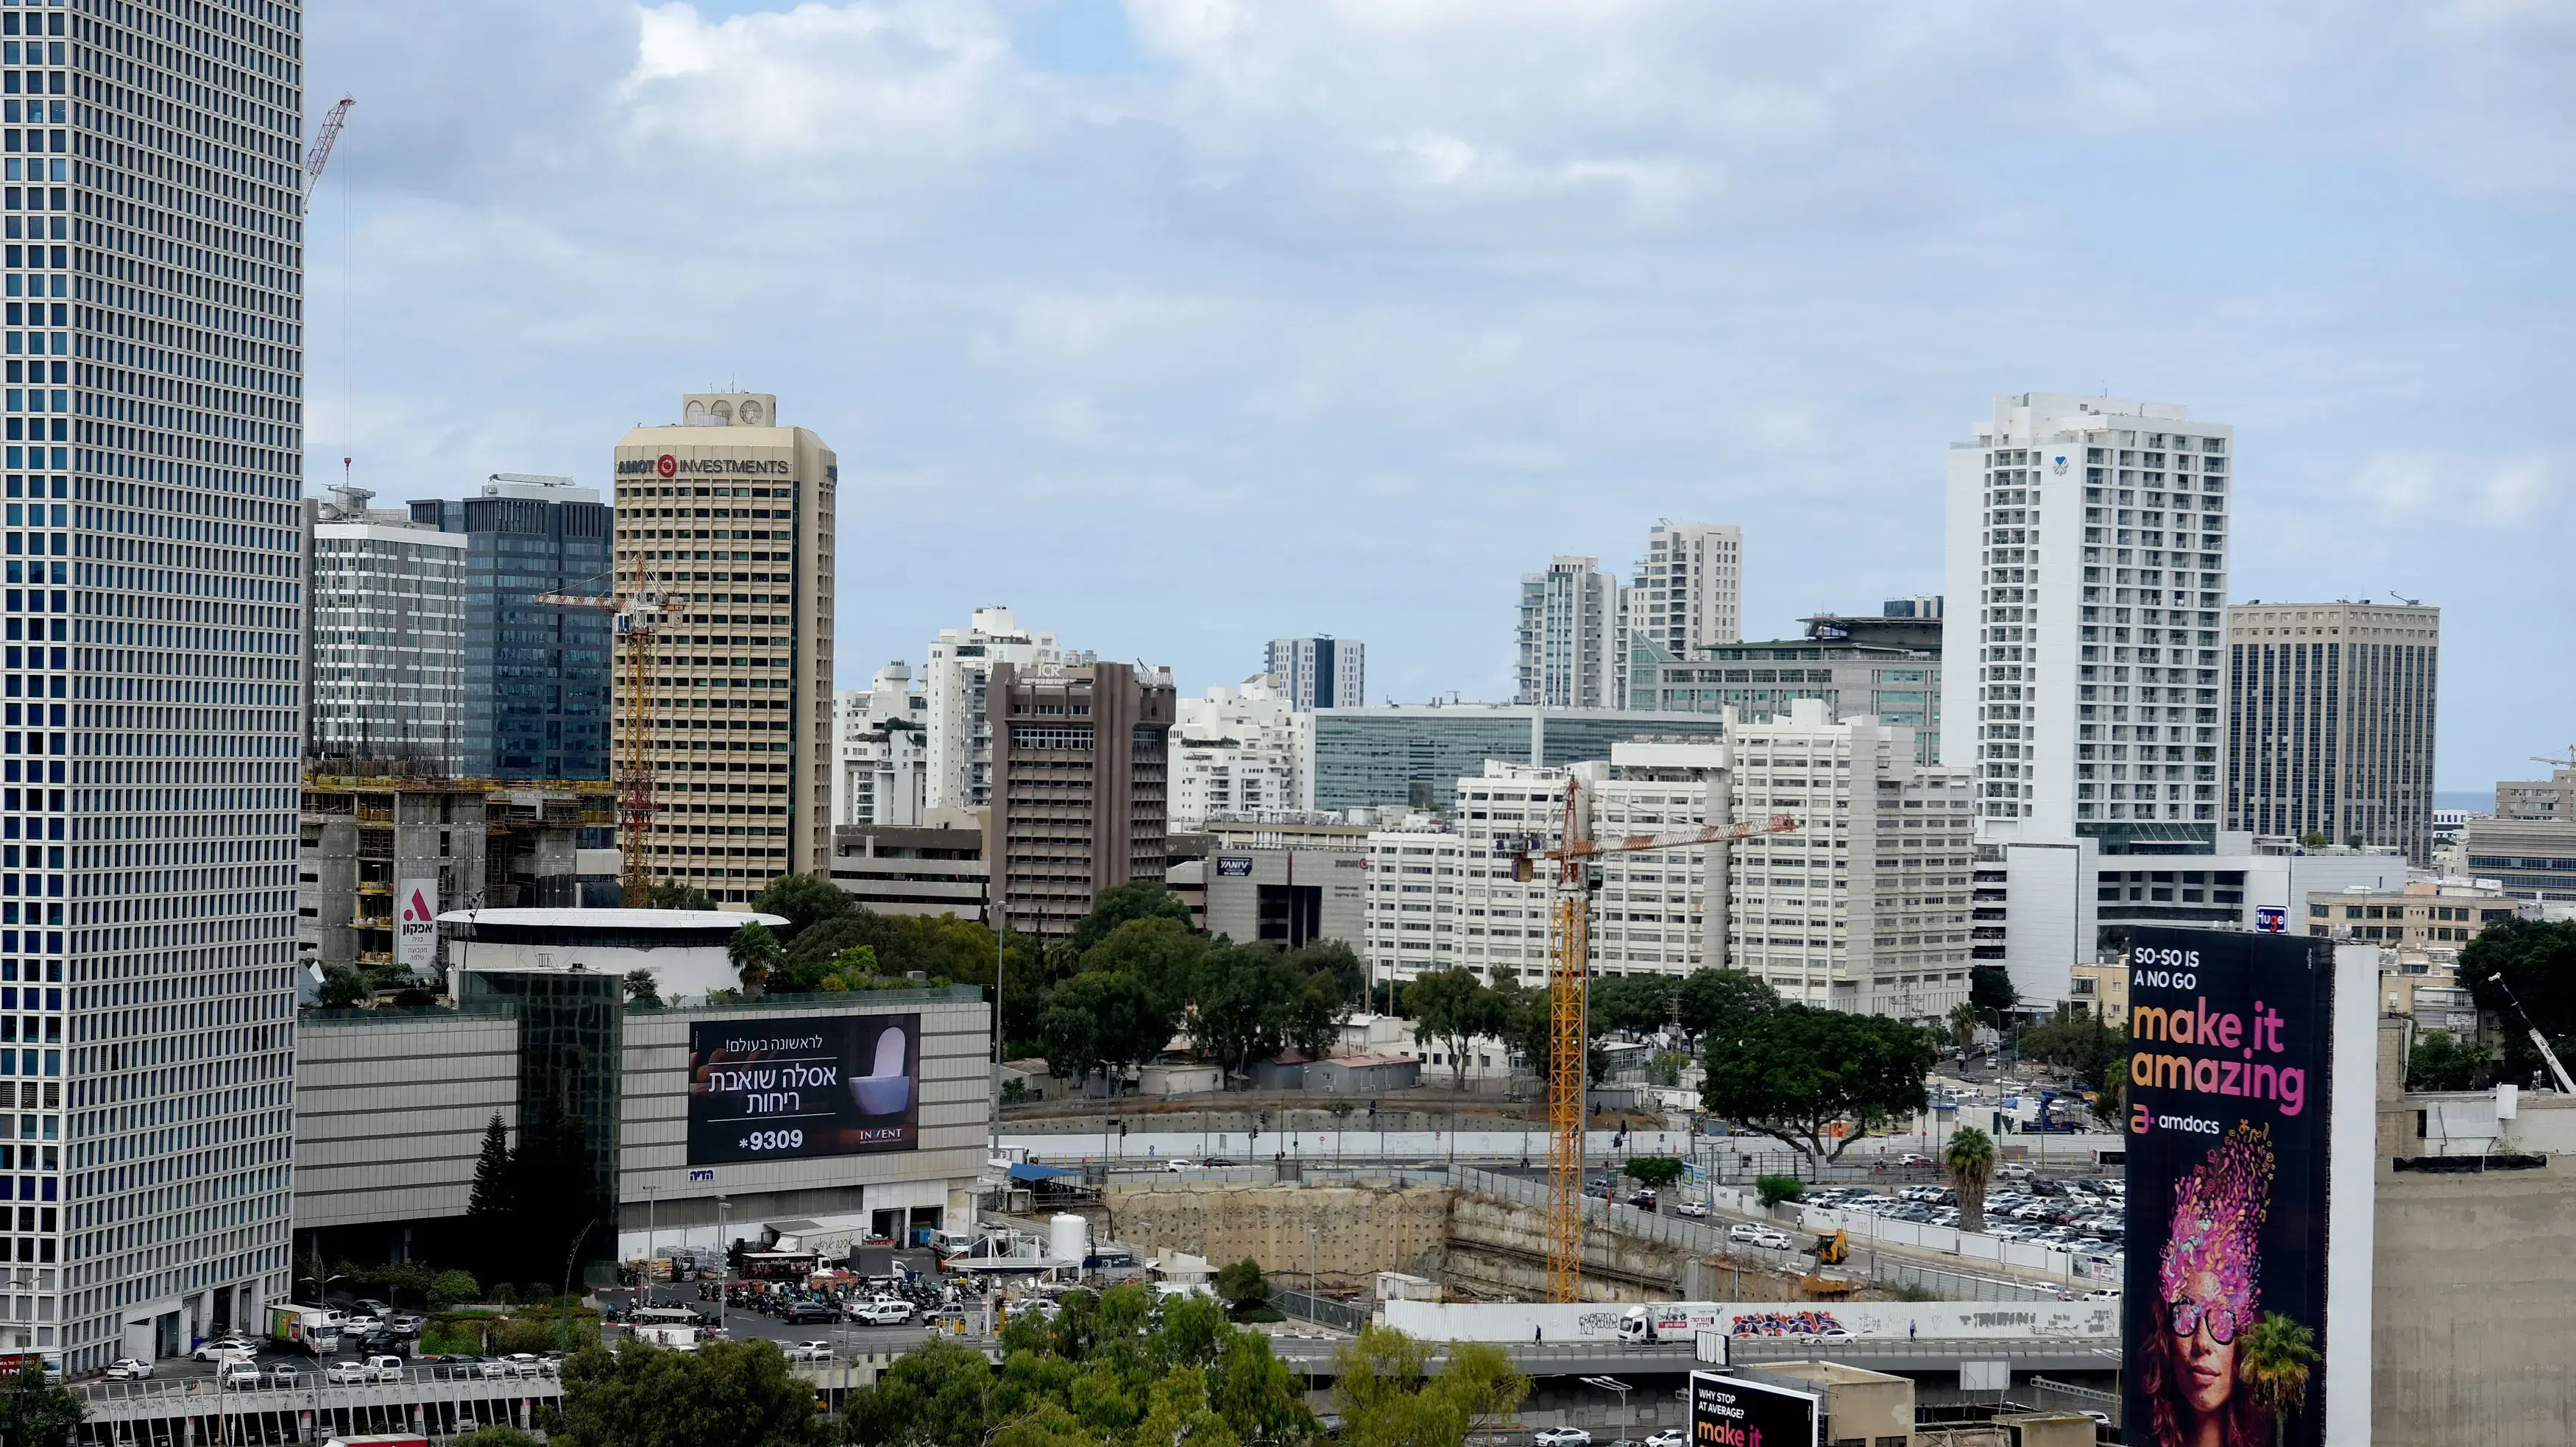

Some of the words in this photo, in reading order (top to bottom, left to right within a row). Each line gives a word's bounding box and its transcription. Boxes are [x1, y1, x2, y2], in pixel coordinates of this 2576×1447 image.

[618, 460, 655, 474] AMOT
[680, 459, 788, 473] INVESTMENTS
[1038, 664, 1060, 676] ICR
[403, 924, 433, 935] אפקון
[2257, 911, 2284, 933] Huge
[2134, 947, 2182, 966] SO-SO
[2184, 951, 2200, 967] IS
[2134, 970, 2145, 986] A
[2147, 971, 2170, 988] NO
[2172, 973, 2196, 990] GO
[2133, 996, 2243, 1048] make
[2254, 1000, 2285, 1052] it
[726, 1037, 768, 1052] בעולם!
[771, 1034, 823, 1051] לראשונה
[709, 1069, 776, 1092] שואבת
[782, 1063, 837, 1088] אסלה
[2131, 1047, 2305, 1116] amazing
[746, 1092, 799, 1114] ריחות
[860, 1129, 902, 1140] INVENT
[2159, 1114, 2220, 1135] amdocs
[1696, 1331, 1726, 1365] NUR
[1699, 1388, 1716, 1400] WHY
[1716, 1392, 1735, 1404] STOP
[1699, 1401, 1707, 1411] AT
[1708, 1404, 1744, 1419] AVERAGE?
[1699, 1420, 1745, 1447] make
[1749, 1423, 1763, 1447] it
